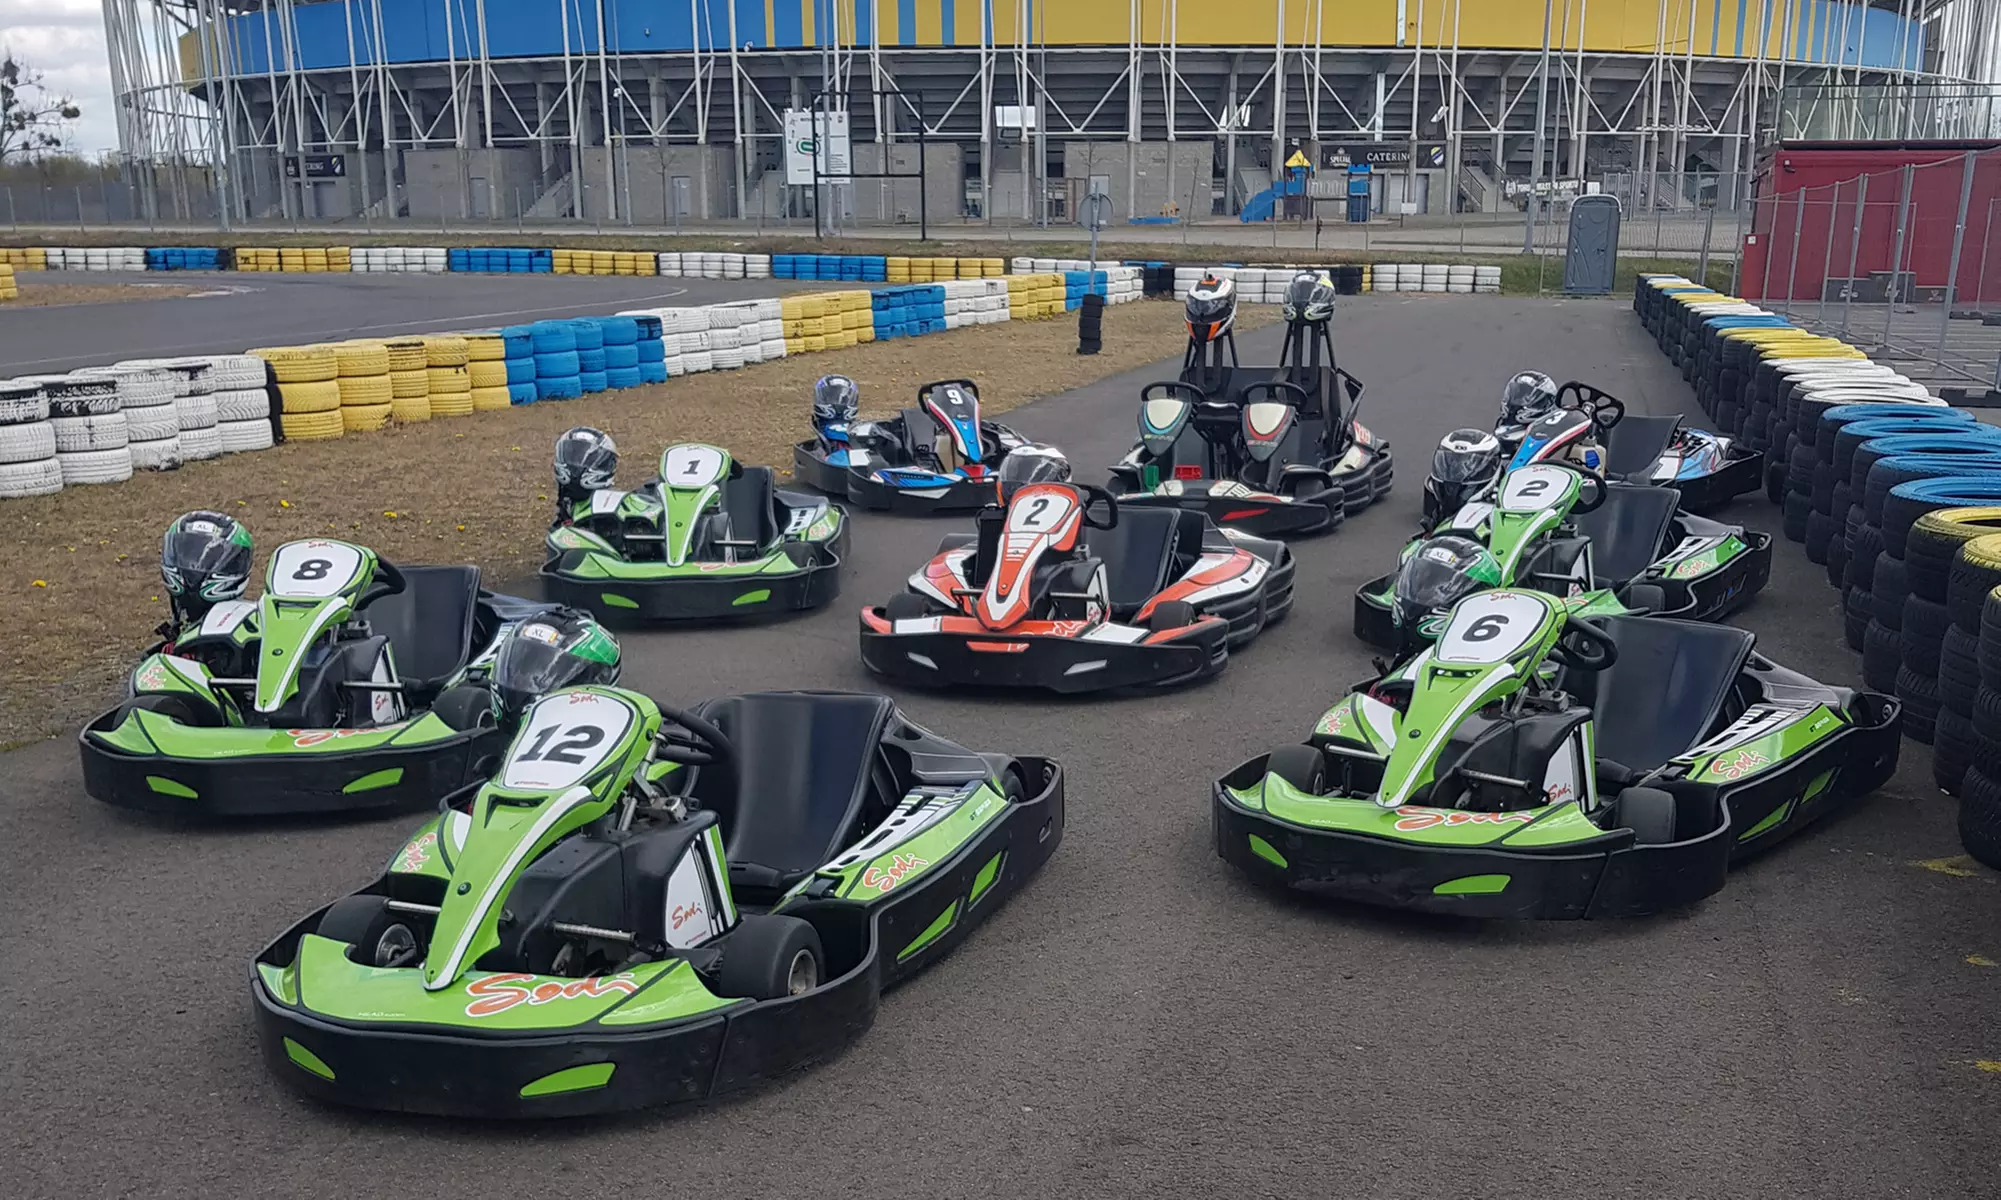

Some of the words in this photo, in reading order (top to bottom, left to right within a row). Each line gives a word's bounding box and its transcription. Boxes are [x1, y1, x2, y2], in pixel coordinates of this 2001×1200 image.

[1366, 152, 1410, 162] CATERIN
[946, 389, 964, 405] 9
[1545, 410, 1568, 425] 3
[682, 459, 701, 475] 1
[1516, 480, 1549, 497] 2
[1022, 498, 1050, 526] 2
[292, 559, 333, 580] 8
[532, 628, 544, 637] XL
[1462, 614, 1510, 642] 6
[515, 723, 606, 766] 12
[1711, 751, 1770, 780] Sodi
[1547, 782, 1572, 803] Sodi
[1395, 805, 1534, 831] Sodi
[863, 852, 929, 892] Sodi
[671, 901, 703, 931] Sodi
[464, 972, 640, 1018] Sodi
